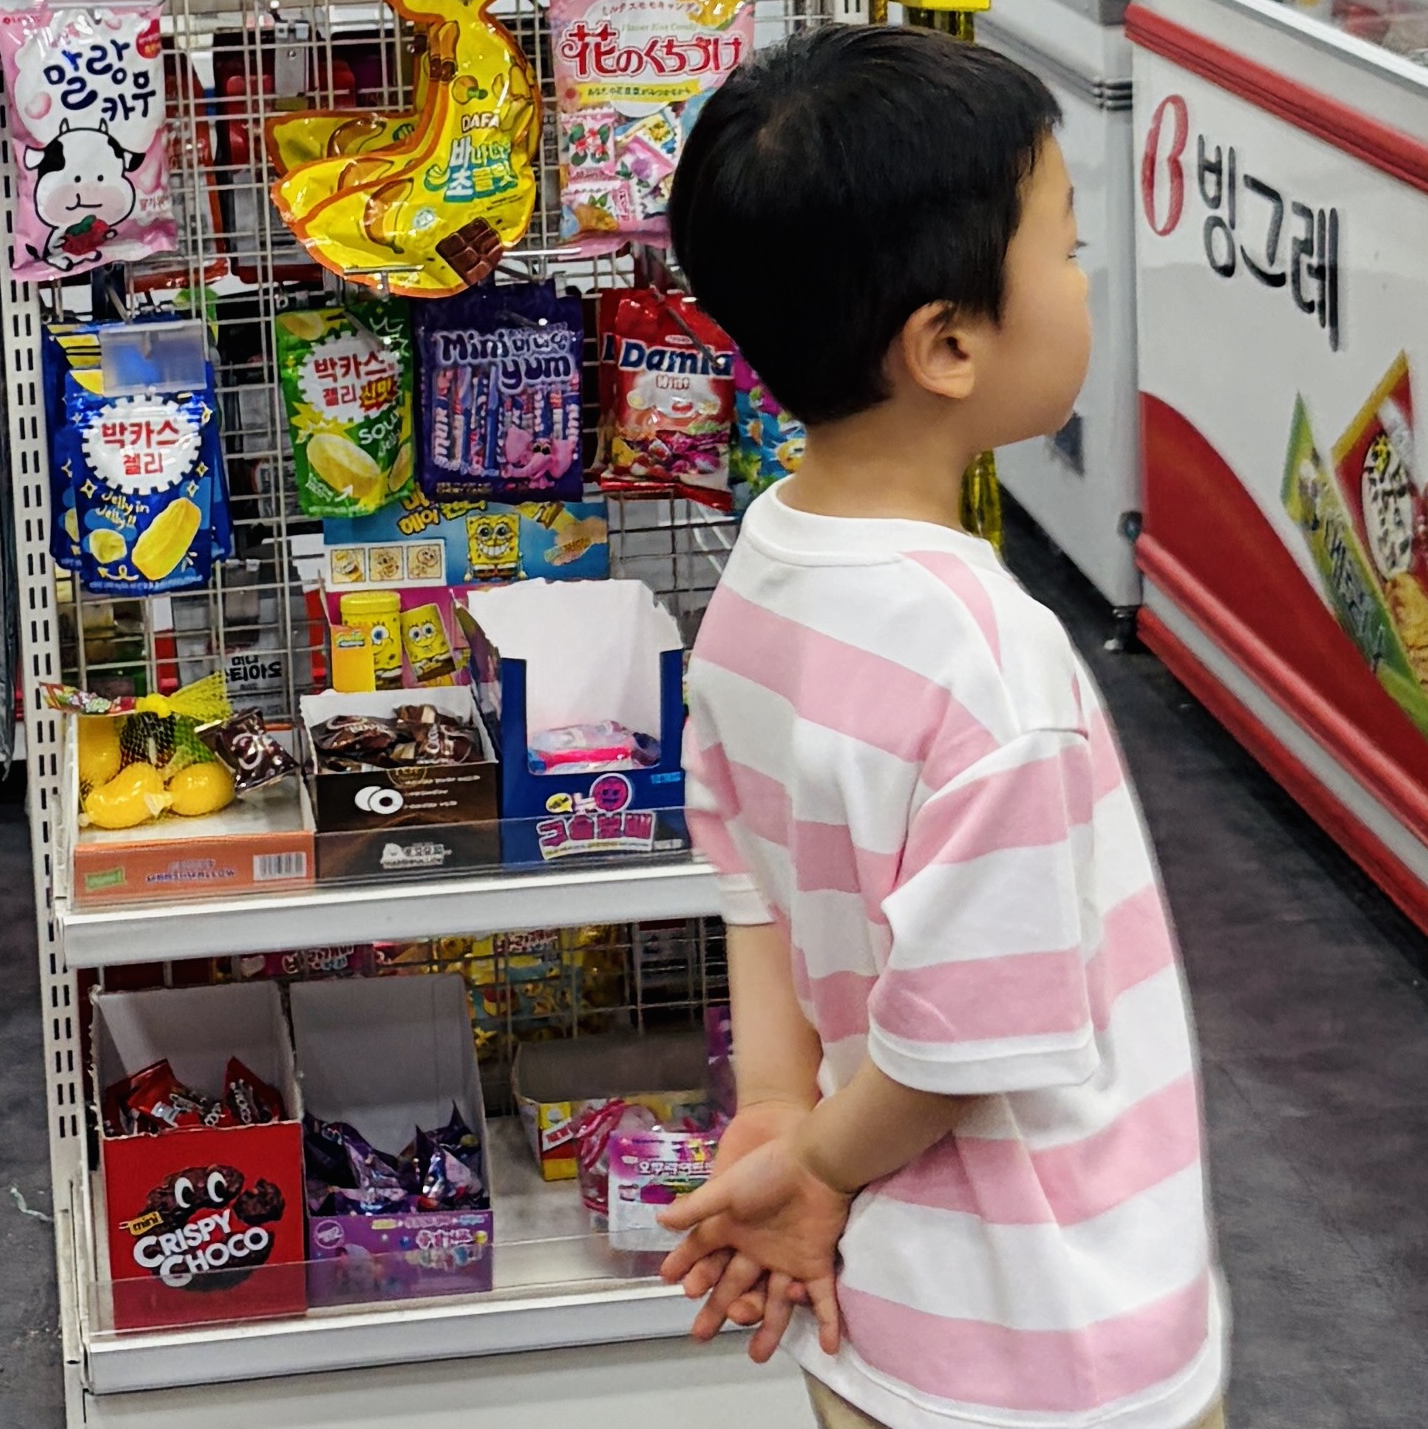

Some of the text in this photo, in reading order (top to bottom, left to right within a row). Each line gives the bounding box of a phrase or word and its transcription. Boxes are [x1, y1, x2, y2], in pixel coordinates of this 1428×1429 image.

[560, 22, 743, 77] 花のくちづけ
[43, 39, 131, 111] 말랑
[101, 70, 157, 122] 카우
[1197, 133, 1340, 353] 빙그레
[440, 331, 510, 362] Mini
[620, 343, 734, 377] Damla
[313, 351, 387, 383] 박카스
[500, 356, 572, 391] yum
[101, 420, 180, 448] 박카스
[122, 451, 165, 476] 젤리
[101, 489, 133, 516] Jelly
[132, 1211, 160, 1232] mini
[133, 1208, 232, 1268] CRISPY
[159, 1226, 270, 1288] CHOCO
